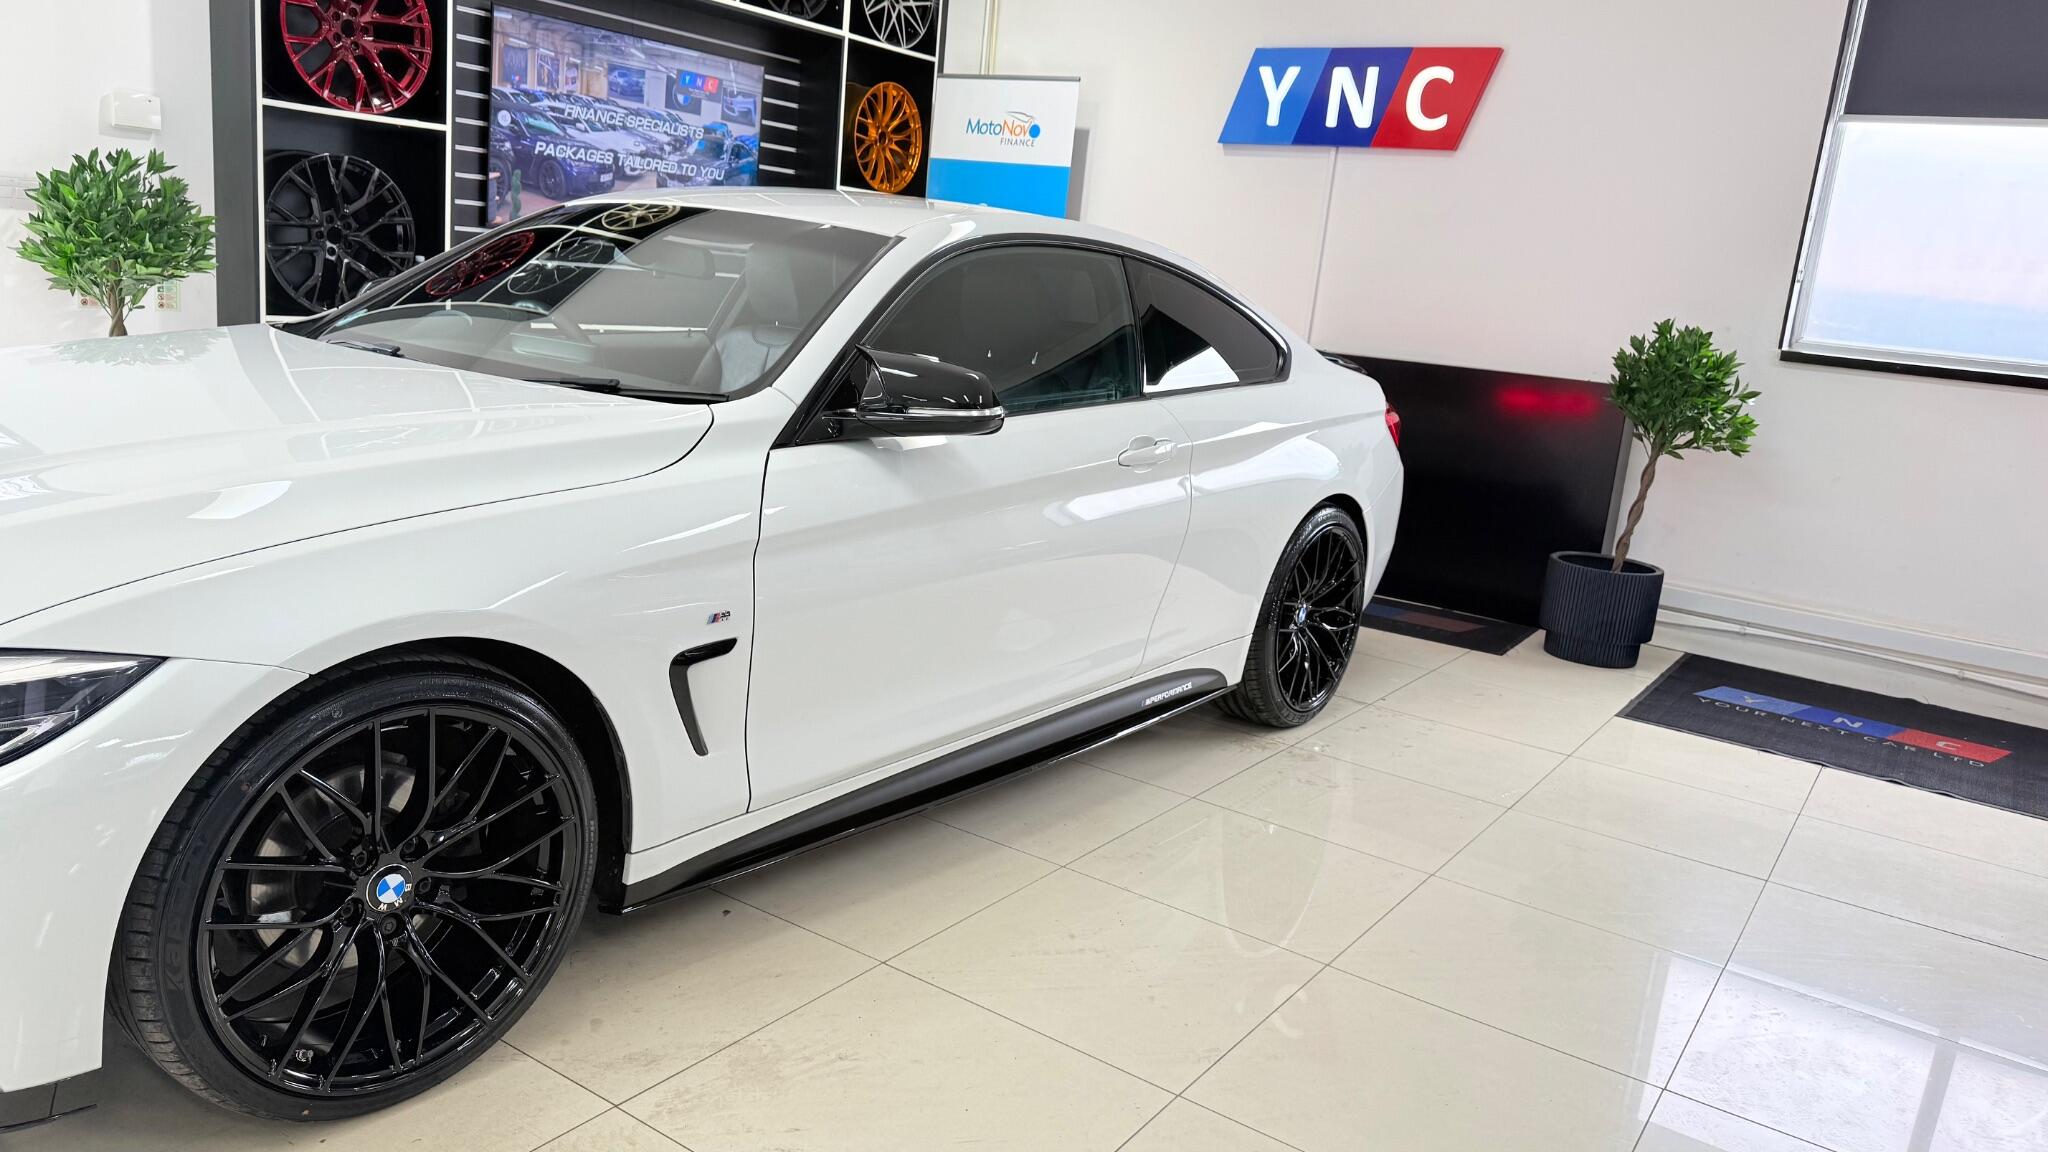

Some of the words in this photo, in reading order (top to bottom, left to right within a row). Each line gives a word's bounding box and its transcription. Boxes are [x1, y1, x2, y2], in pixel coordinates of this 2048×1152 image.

[1258, 65, 1455, 132] YNC
[564, 104, 625, 127] FINANCE
[624, 116, 705, 139] SPECIALISTS
[534, 141, 614, 164] PACKAGES
[617, 153, 677, 173] TAILORED
[682, 163, 697, 176] TO
[700, 166, 725, 180] YOU
[1000, 137, 1036, 147] FINANCE
[1698, 697, 1768, 717] YOUR
[1780, 716, 1850, 736] NEXT
[1863, 735, 1917, 752] CAR
[1933, 751, 1985, 767] LTD
